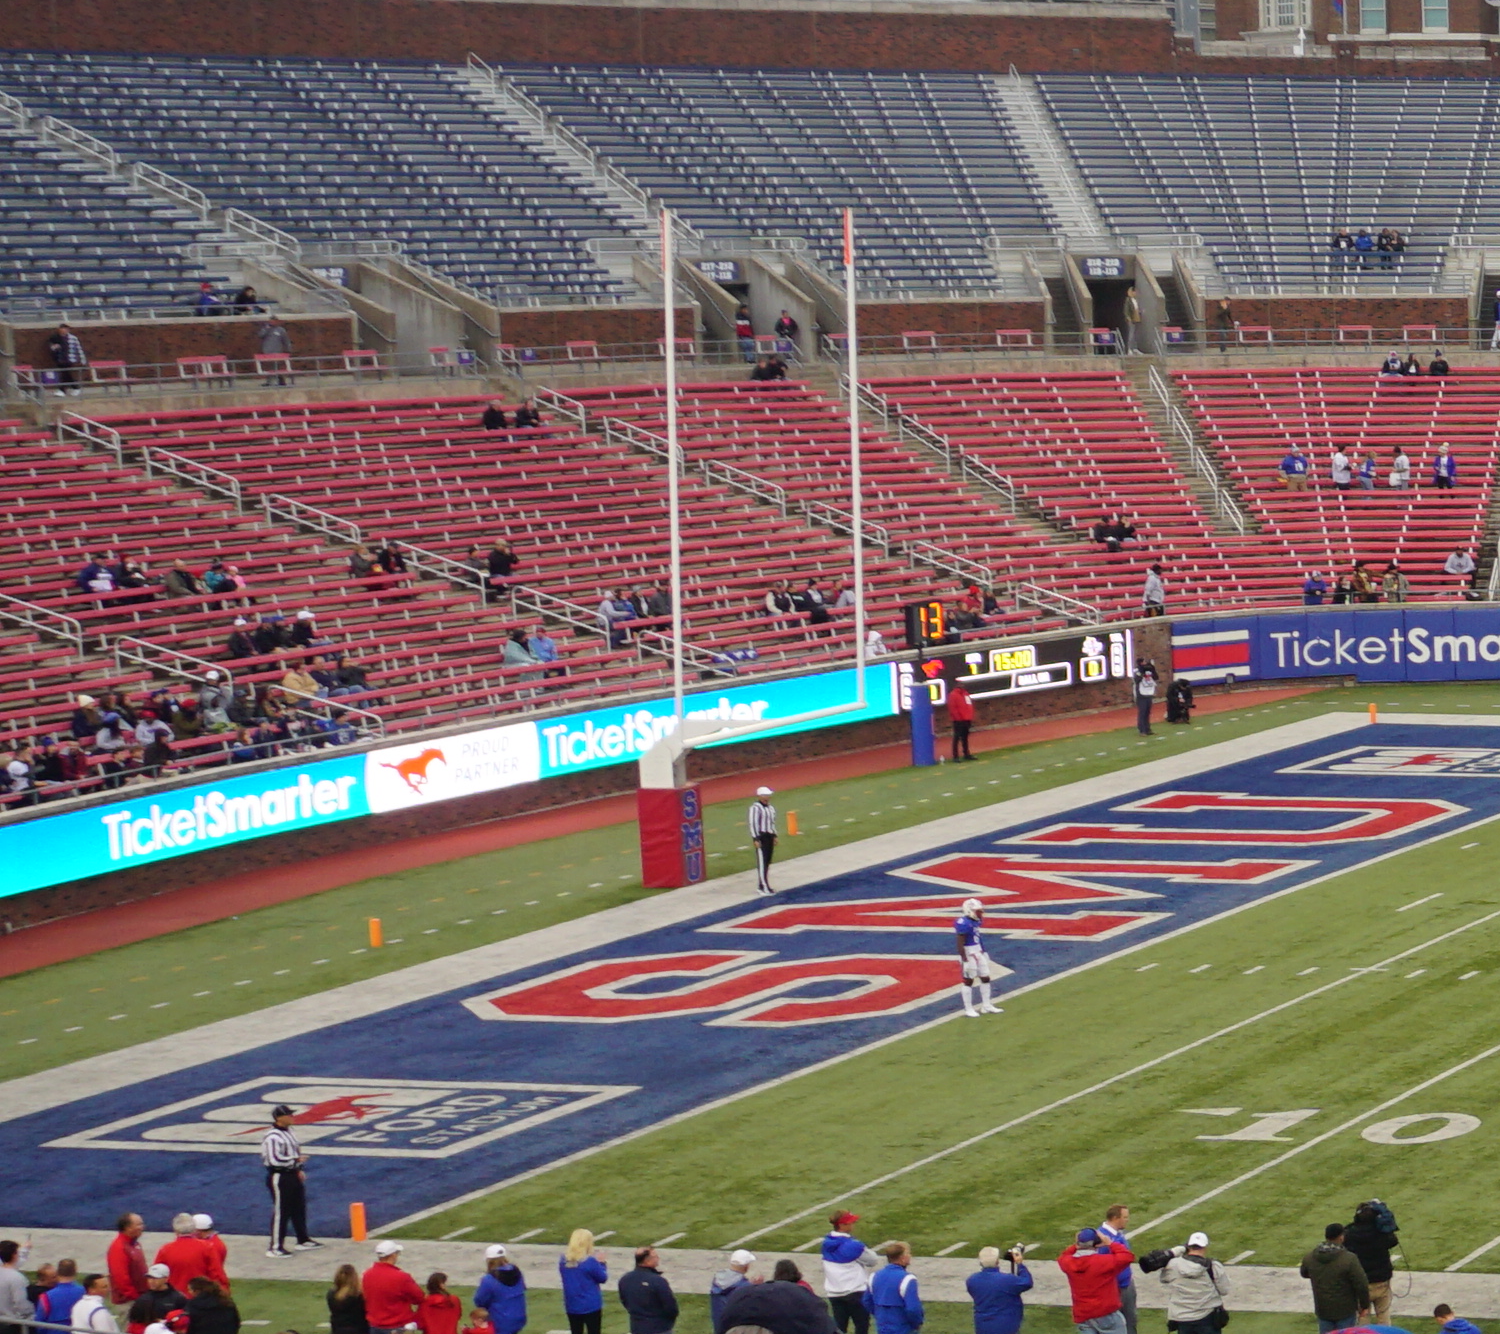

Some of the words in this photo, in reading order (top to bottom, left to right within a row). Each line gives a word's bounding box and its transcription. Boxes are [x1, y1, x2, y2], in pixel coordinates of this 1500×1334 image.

[919, 601, 945, 639] 13
[994, 650, 1033, 672] 15:00
[455, 756, 520, 781] PARTNER
[462, 736, 509, 758] PROUD
[101, 773, 357, 860] TicketSmarter
[681, 788, 705, 884] SMU
[462, 790, 1471, 1029] SMU
[336, 1094, 508, 1144] FORD
[410, 1096, 568, 1146] STADIUM
[1196, 1107, 1481, 1145] 10
